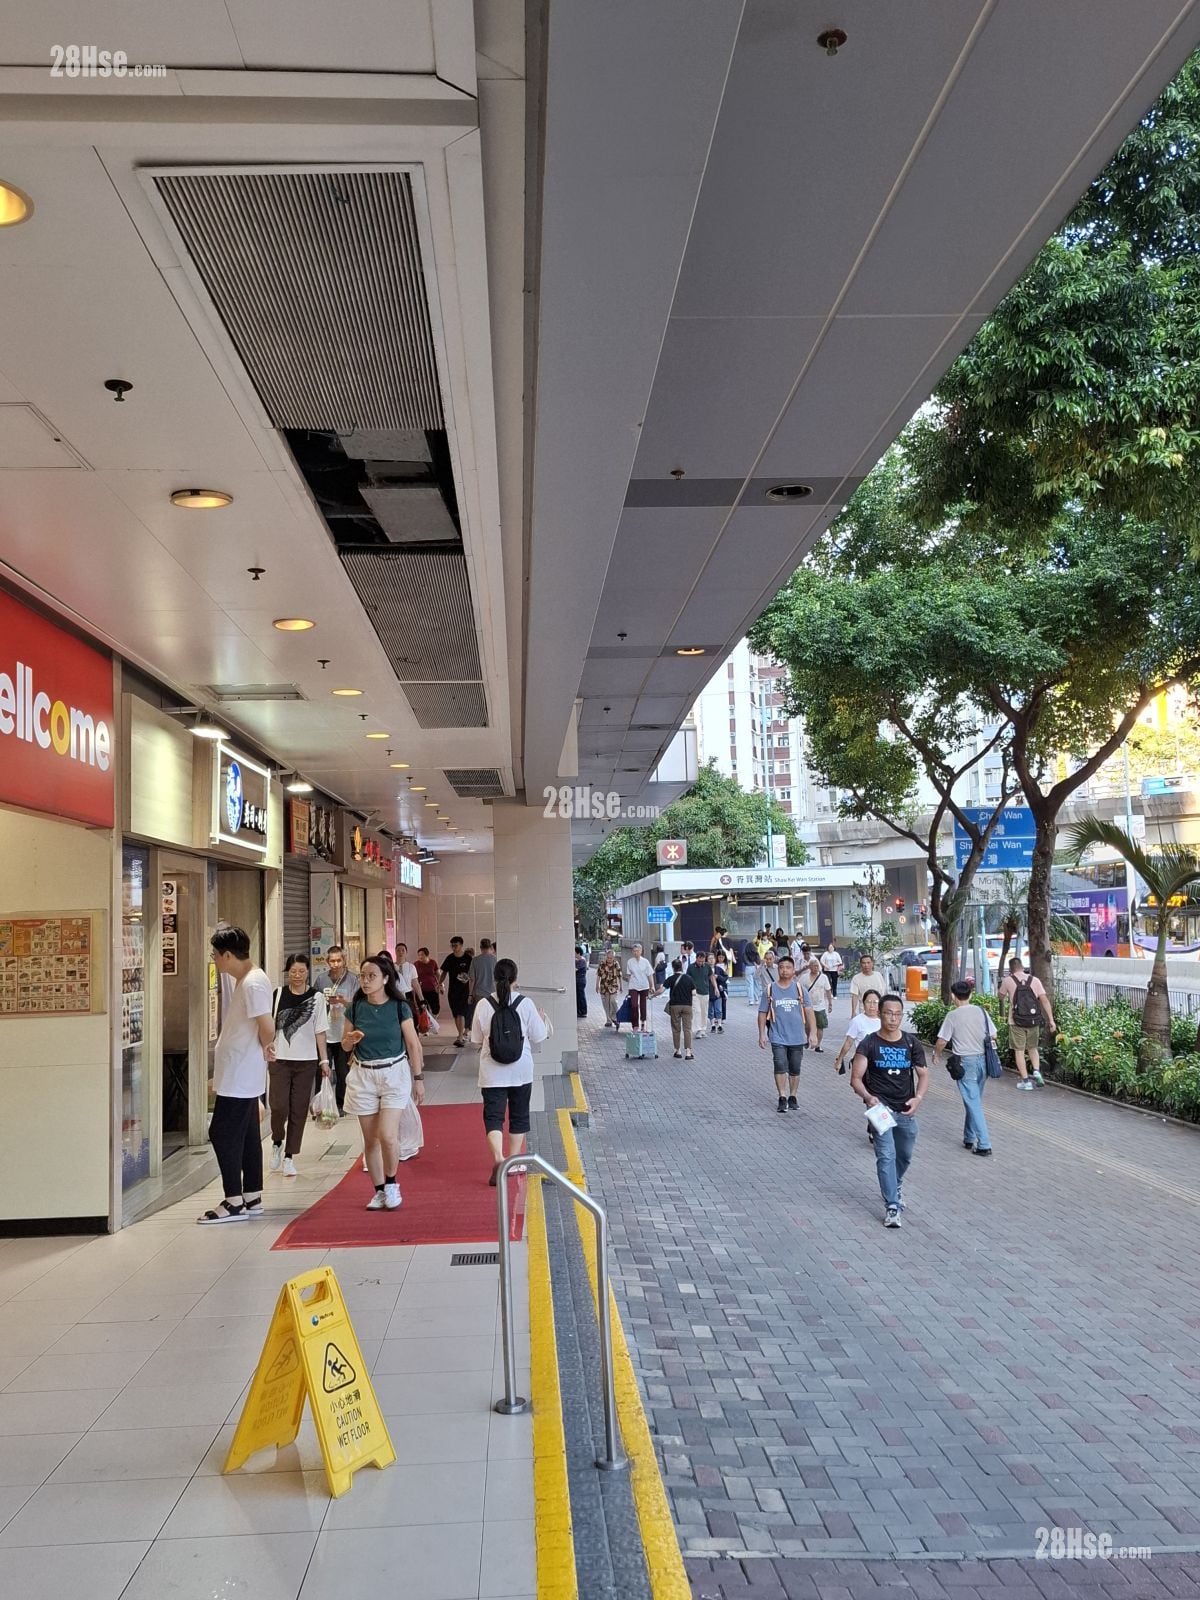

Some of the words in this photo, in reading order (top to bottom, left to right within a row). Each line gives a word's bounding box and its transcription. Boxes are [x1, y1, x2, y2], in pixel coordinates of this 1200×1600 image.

[0, 661, 110, 771] ellcome
[882, 1053, 906, 1061] YOUR
[330, 1389, 361, 1413] 小心地滑
[336, 1407, 363, 1430] CAUTION
[336, 1429, 352, 1449] WET
[350, 1421, 371, 1442] FLOOR
